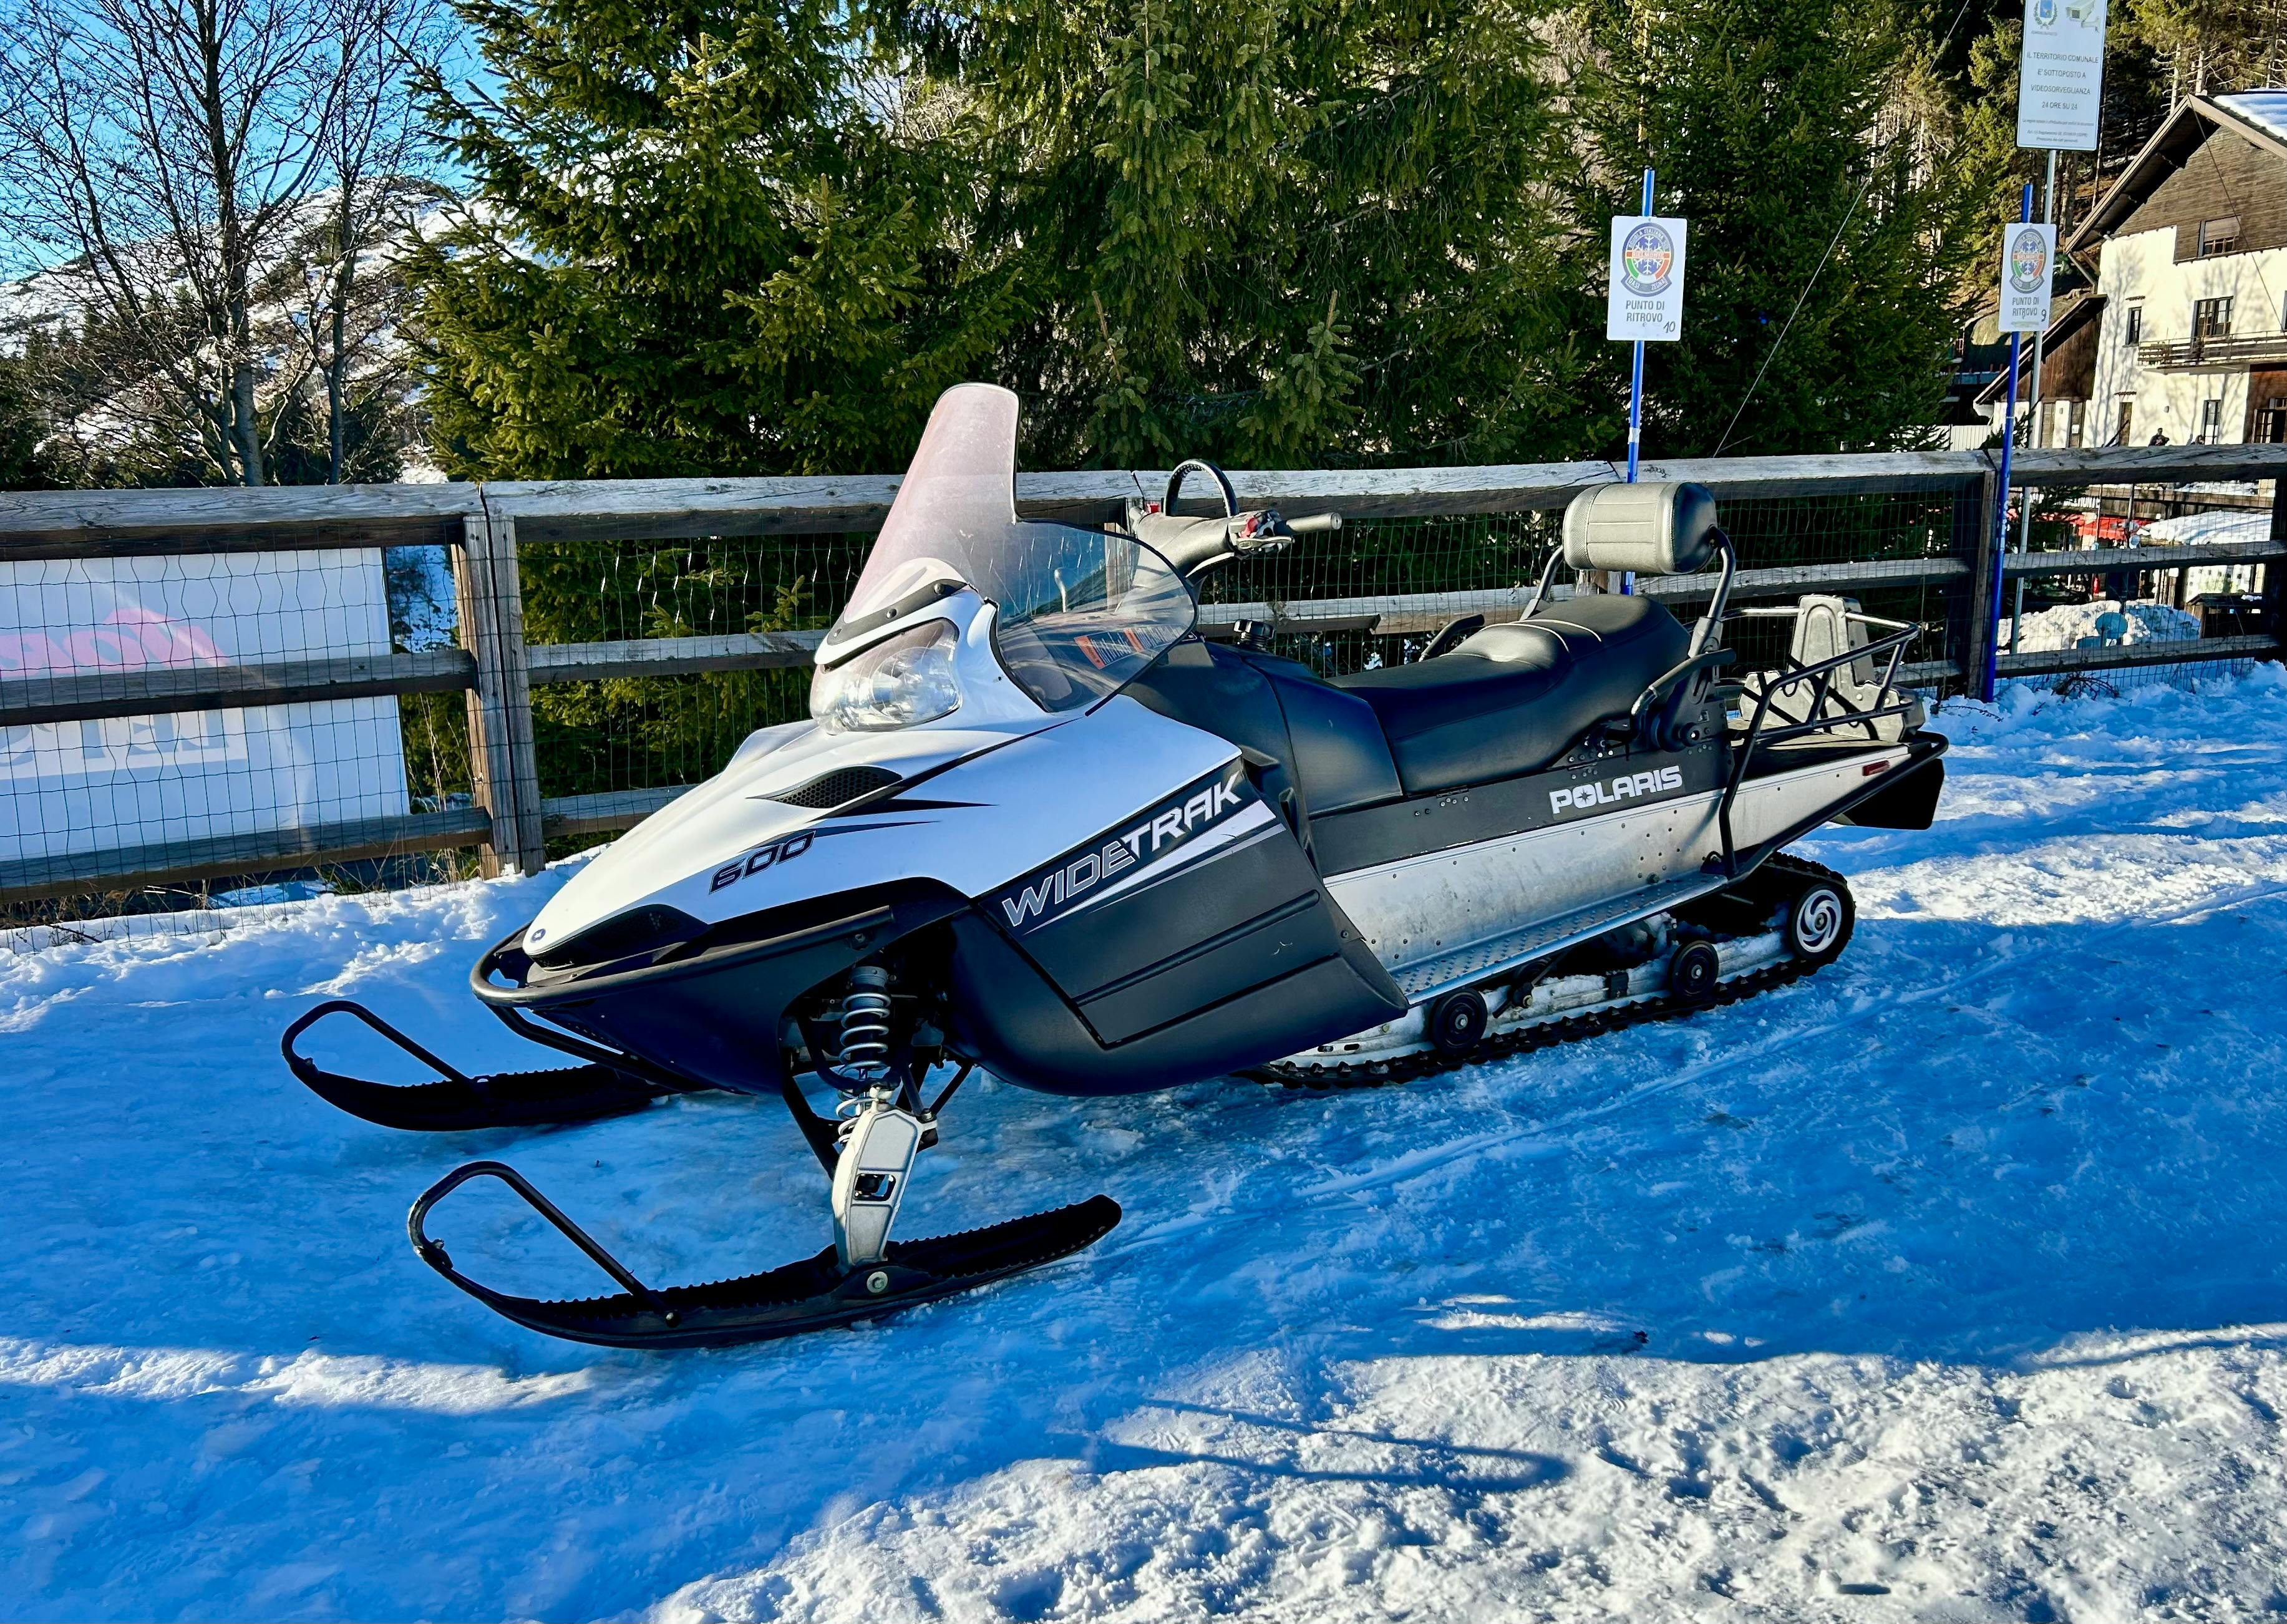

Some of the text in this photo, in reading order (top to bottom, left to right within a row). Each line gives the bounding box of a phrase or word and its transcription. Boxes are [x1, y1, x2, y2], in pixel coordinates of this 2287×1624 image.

[2033, 52, 2067, 61] TERRITORIO
[2068, 54, 2099, 63] COMUNALE
[2044, 69, 2081, 78] SOTTOPOSTO
[2031, 84, 2090, 95] VIDEOSORVEGLIANZA
[1626, 300, 1664, 310] PUNTO DI
[2012, 297, 2039, 306] PUNTO DI
[2013, 308, 2037, 316] RITROVO
[2041, 309, 2047, 322] 9
[1626, 313, 1663, 323] RITROVO
[1663, 321, 1676, 334] 10
[1549, 765, 1682, 814] POLARIS
[1002, 770, 1241, 927] WIDETRAK
[709, 830, 816, 895] 600
